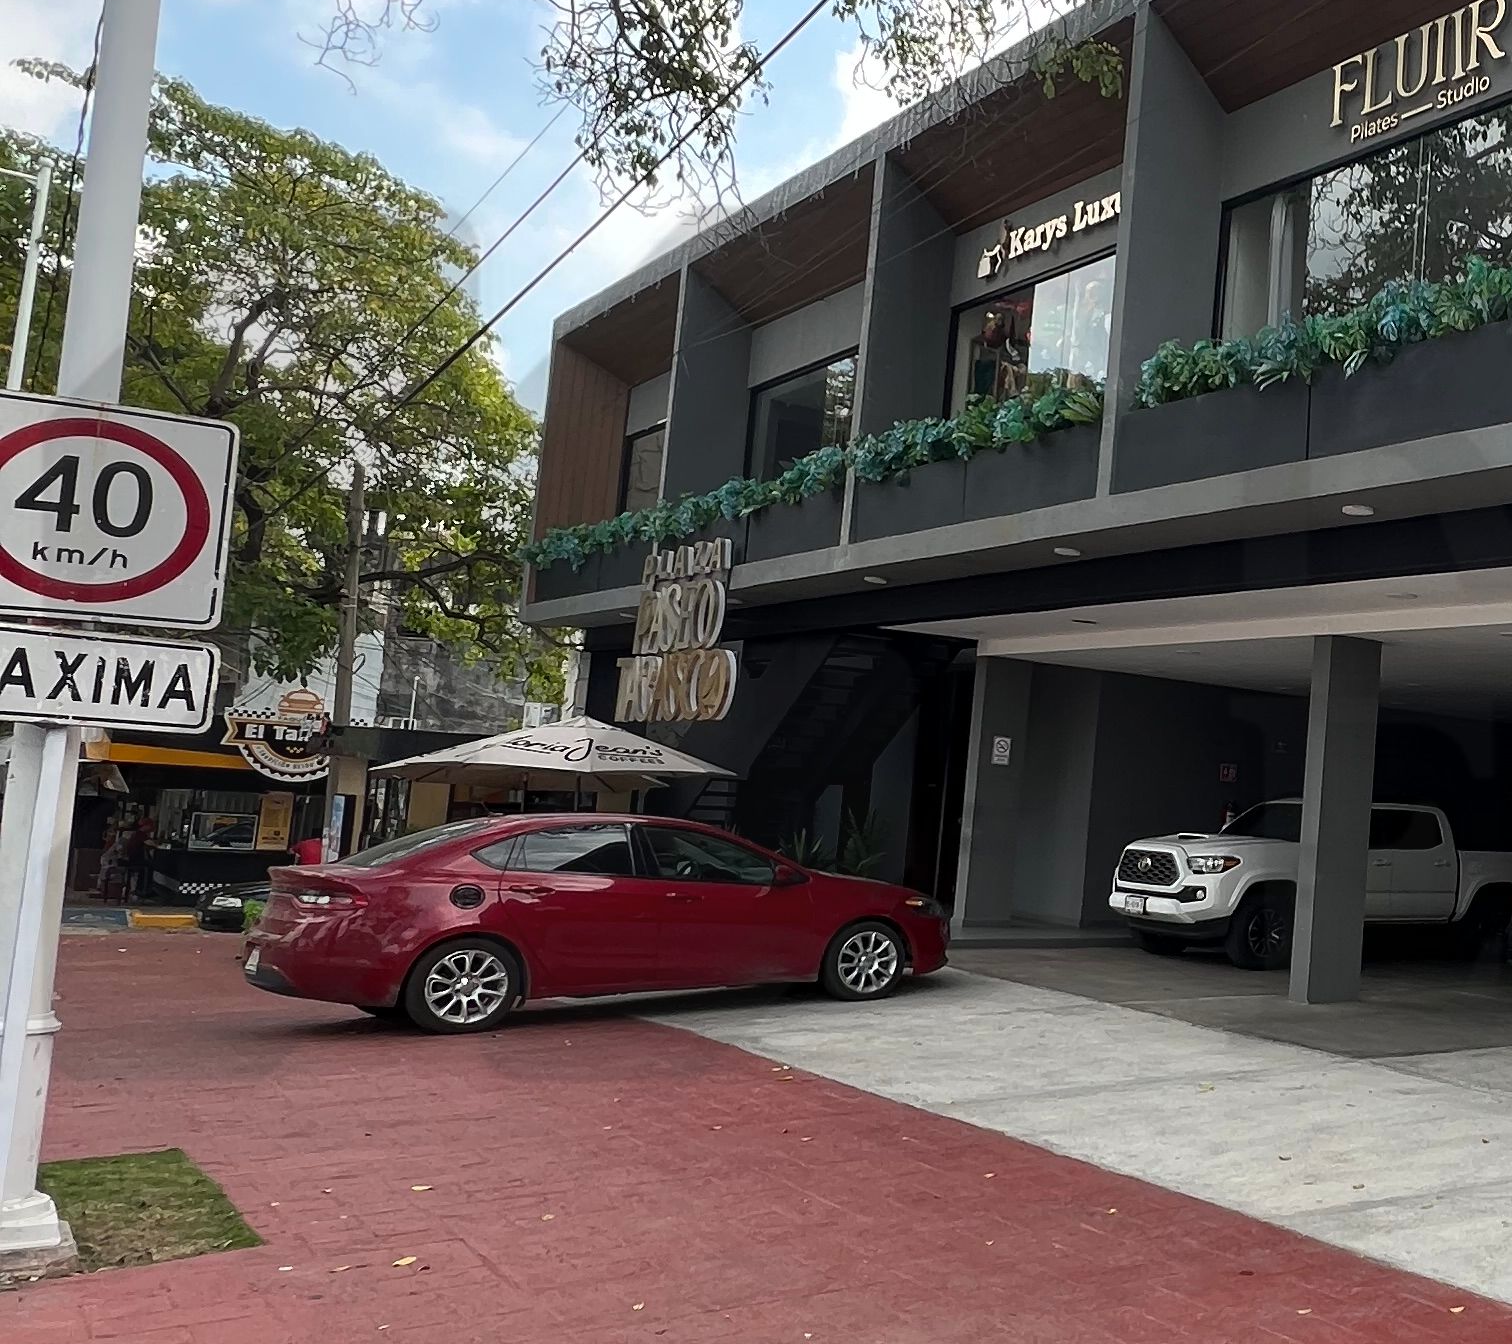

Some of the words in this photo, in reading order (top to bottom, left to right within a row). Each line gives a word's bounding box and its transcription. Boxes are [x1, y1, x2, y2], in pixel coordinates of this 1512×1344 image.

[1350, 111, 1400, 144] Pilates
[1436, 75, 1491, 110] Studio
[1008, 214, 1068, 260] Karys
[14, 454, 153, 538] 40
[31, 541, 128, 569] km/h
[642, 537, 732, 590] PLAZA
[632, 579, 726, 655] PASEO
[614, 649, 737, 723] TABASCO
[244, 723, 265, 739] El
[597, 754, 666, 765] COFFEES
